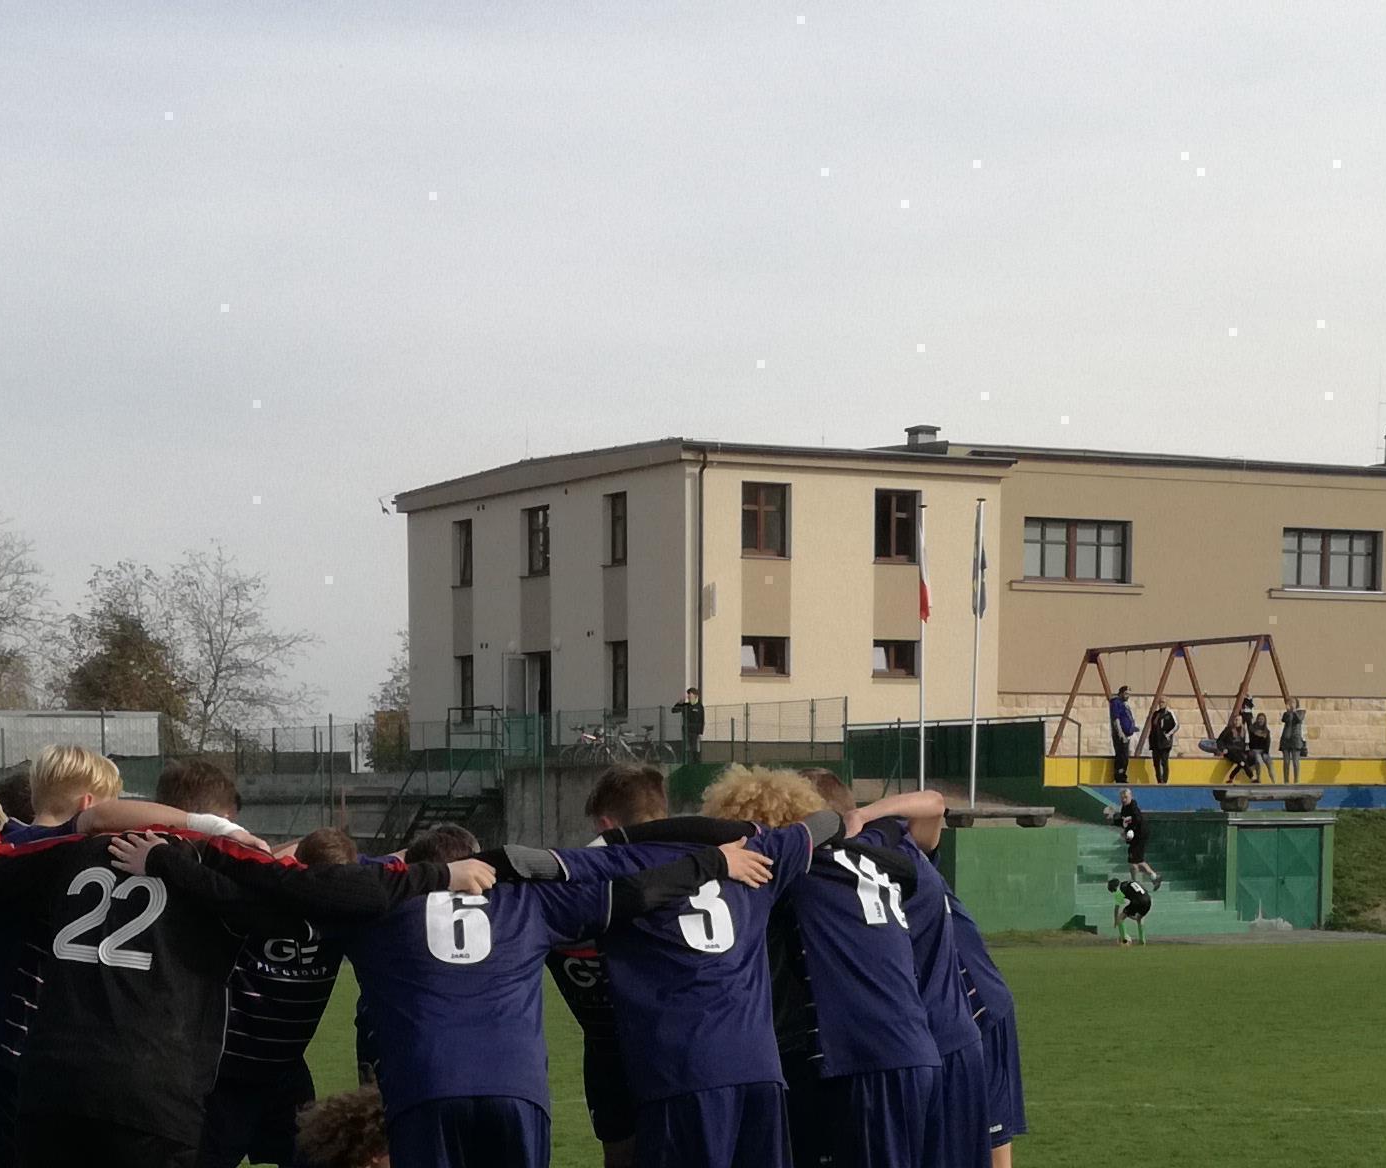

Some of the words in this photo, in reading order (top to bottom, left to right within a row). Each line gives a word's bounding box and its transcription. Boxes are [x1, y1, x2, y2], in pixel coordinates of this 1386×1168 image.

[53, 867, 167, 971] 22
[426, 890, 491, 964] 6
[678, 879, 735, 953] 3
